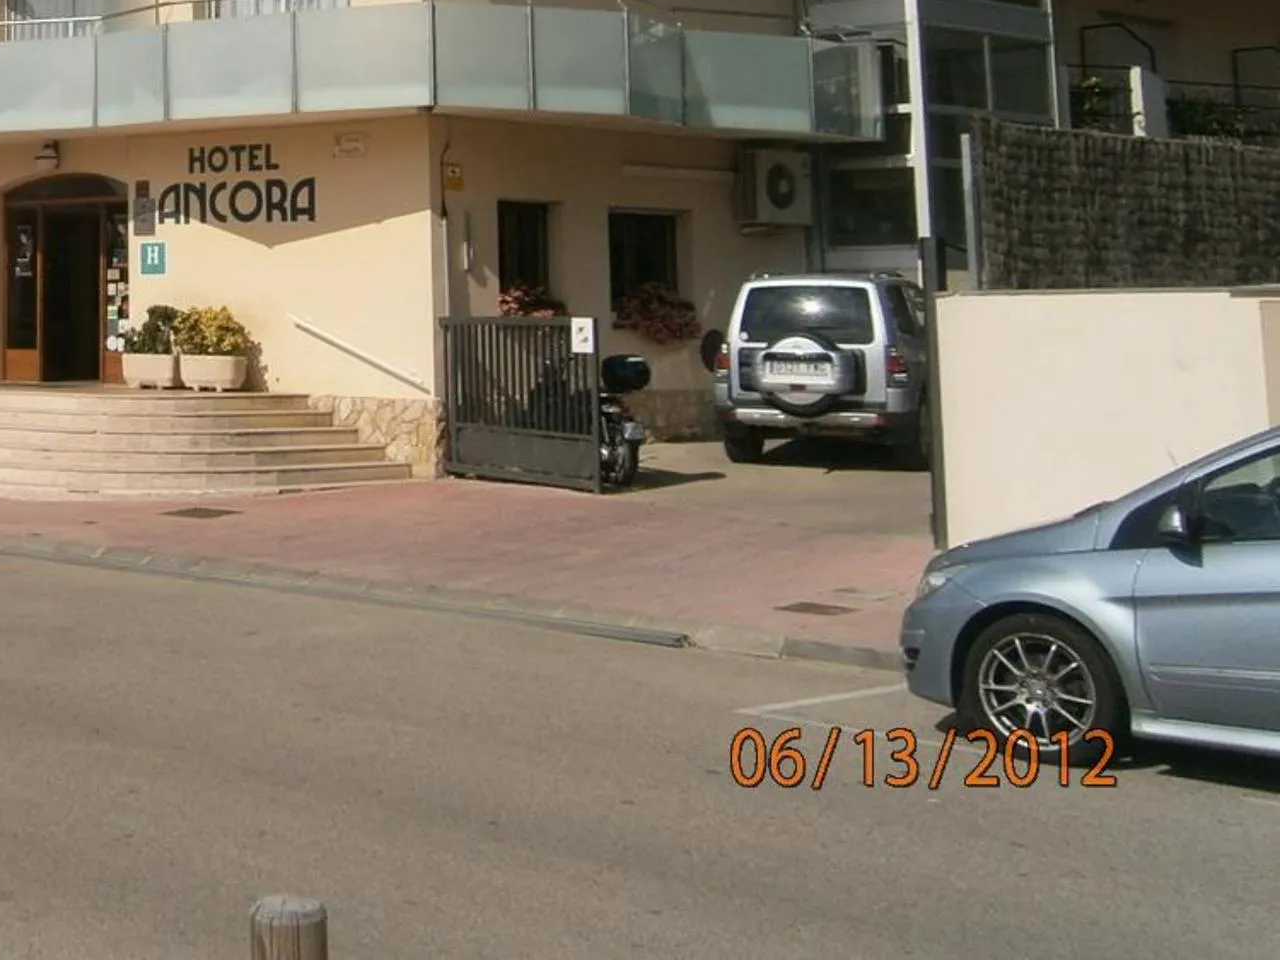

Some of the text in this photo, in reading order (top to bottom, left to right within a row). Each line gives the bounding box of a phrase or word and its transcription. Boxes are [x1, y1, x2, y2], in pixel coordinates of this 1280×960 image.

[188, 143, 280, 174] HOTEL
[158, 177, 317, 225] ANCORA
[147, 246, 160, 266] H
